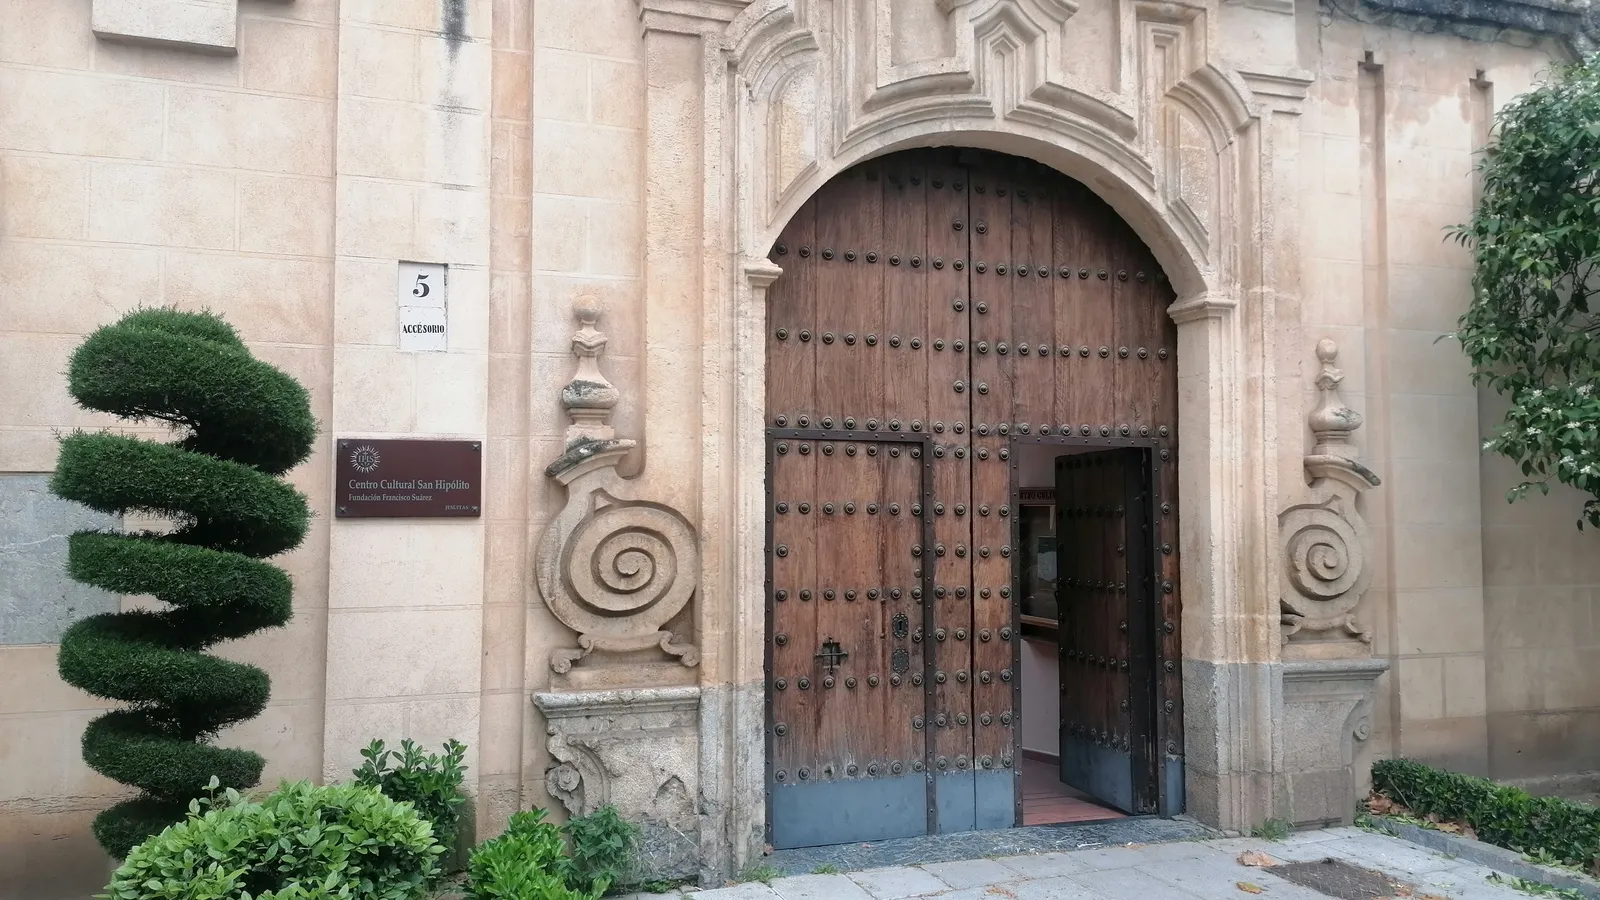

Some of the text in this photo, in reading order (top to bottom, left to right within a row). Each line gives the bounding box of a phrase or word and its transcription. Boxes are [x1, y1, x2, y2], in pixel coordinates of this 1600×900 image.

[412, 274, 430, 298] 5
[348, 479, 470, 493] Centro Cultural San Hipólito
[348, 493, 433, 501] Fundación Francisco Suárez
